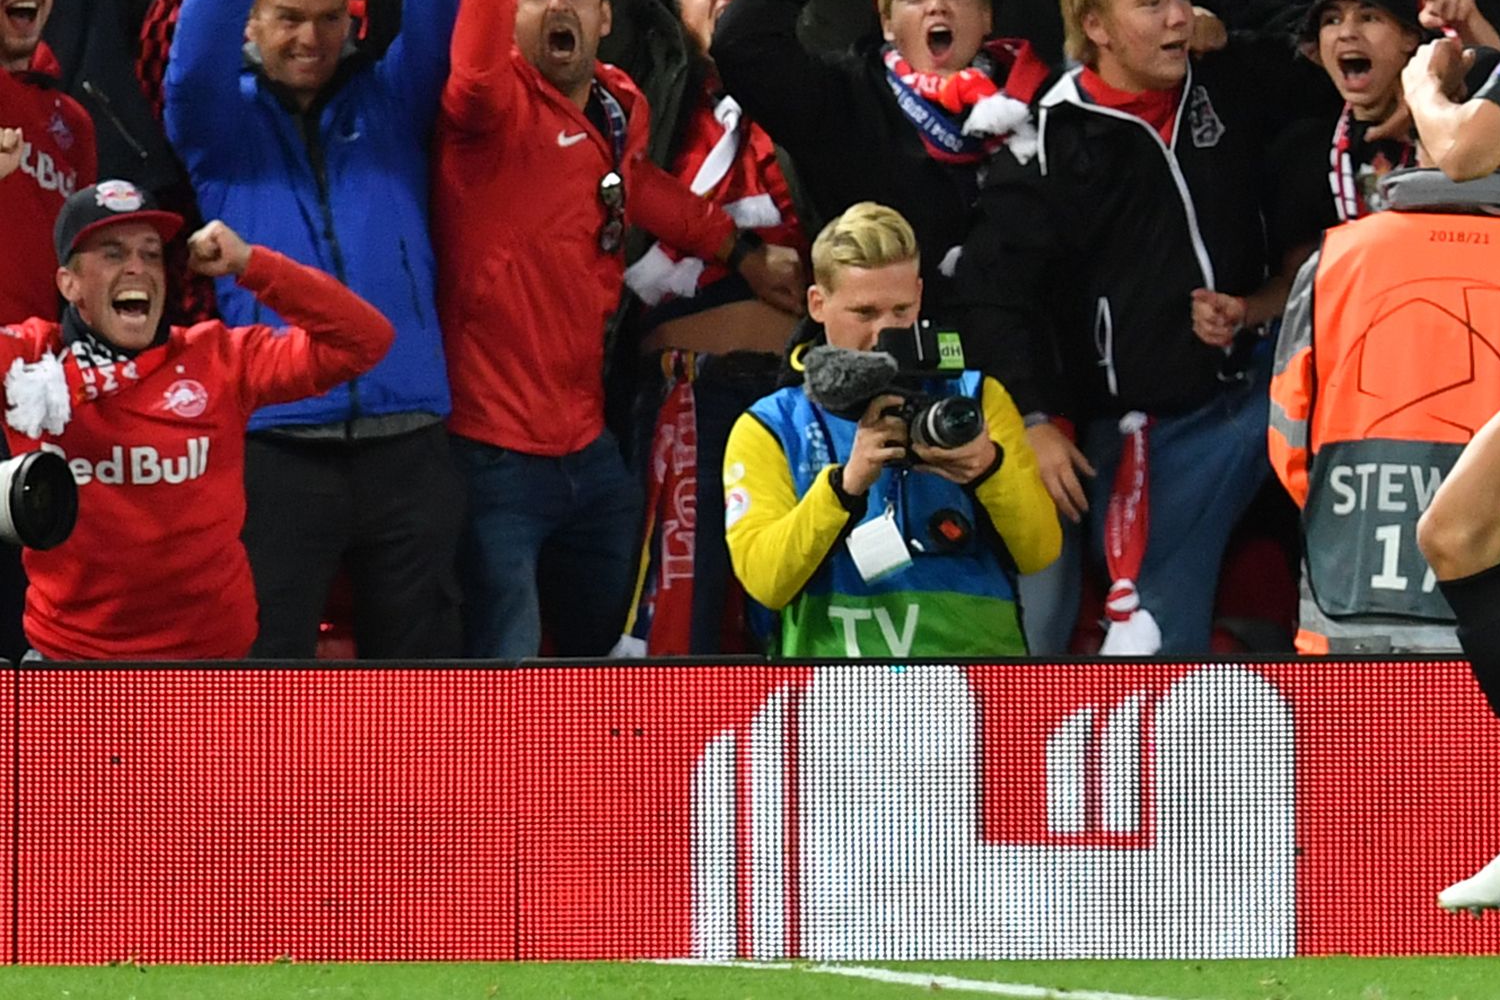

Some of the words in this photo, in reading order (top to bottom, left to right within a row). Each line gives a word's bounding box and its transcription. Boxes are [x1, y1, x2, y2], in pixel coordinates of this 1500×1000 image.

[1429, 230, 1490, 245] 2018/21
[129, 436, 210, 485] Bull
[827, 603, 920, 659] TV
